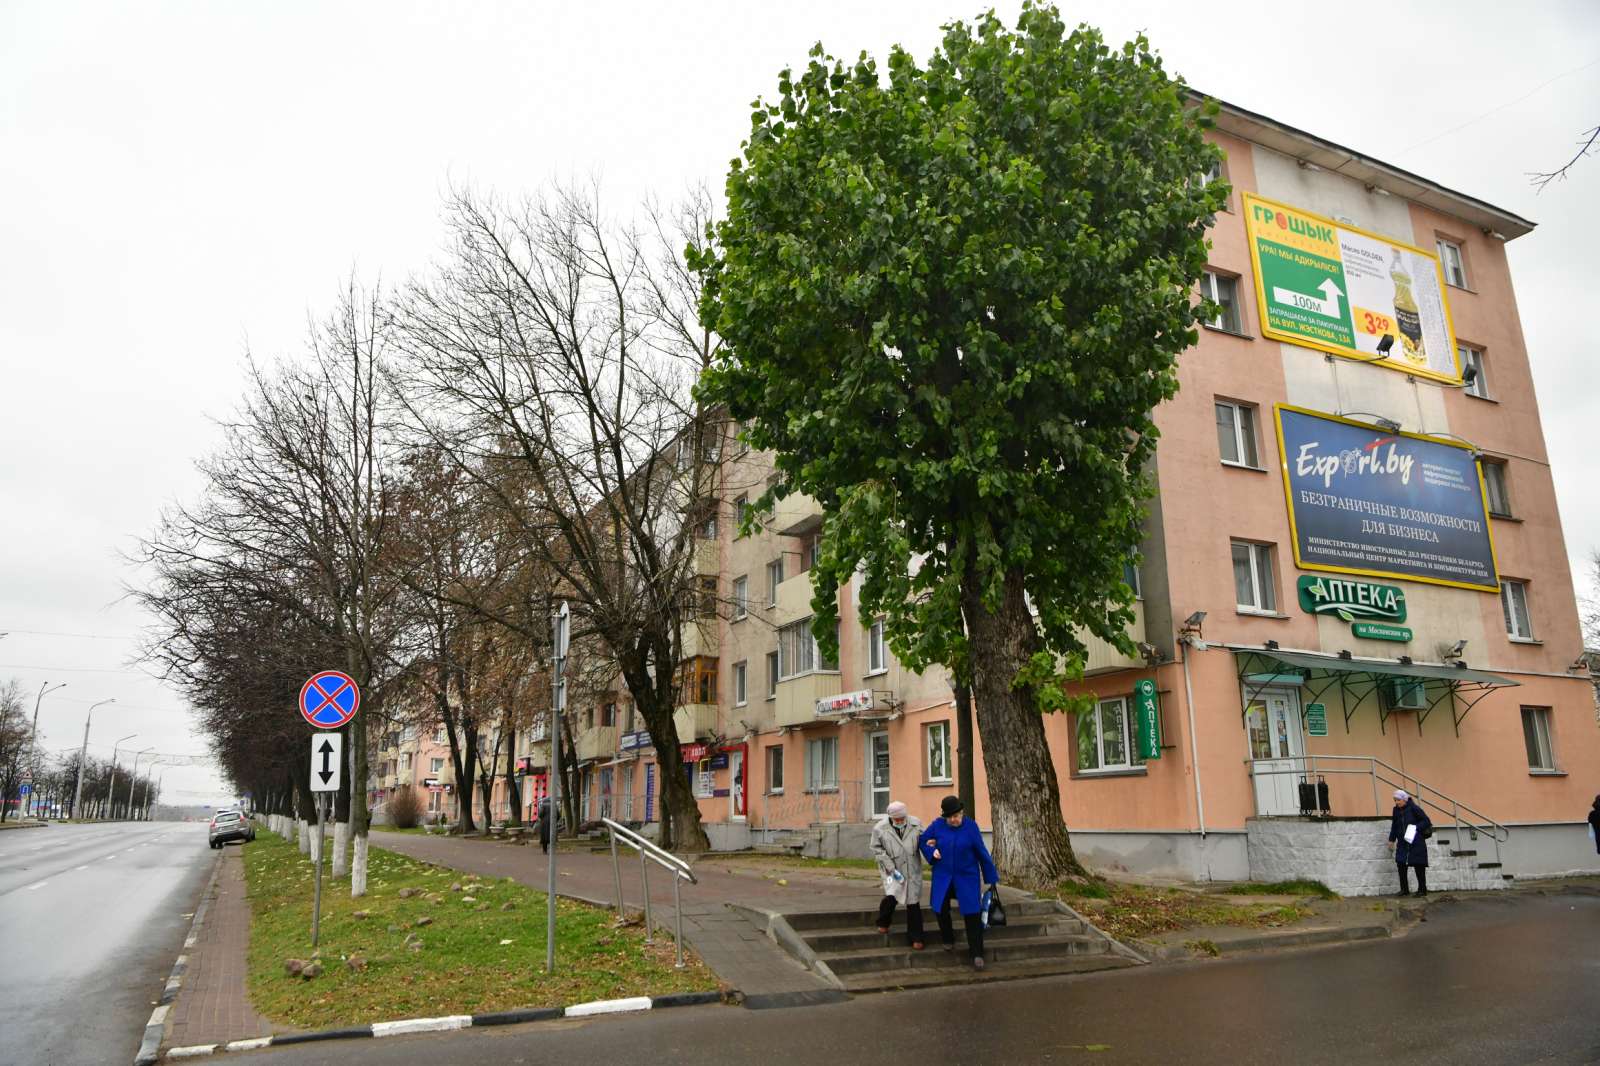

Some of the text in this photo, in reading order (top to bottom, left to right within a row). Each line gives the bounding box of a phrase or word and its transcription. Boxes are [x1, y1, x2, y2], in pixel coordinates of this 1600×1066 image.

[1301, 490, 1480, 533] БЕЗГРАНИЧНЫЕ ВОЗМОЖНОСТИ
[1362, 519, 1440, 543] ДЛЯ БИЗНЕСА
[1307, 546, 1365, 560] НАЦИОНАЛЬНЫЙ
[1308, 536, 1360, 549] МИНИСТЕРСТВО
[1361, 543, 1407, 557] ИНОСТРАННЫХ
[1316, 577, 1398, 611] АПТЕКА
[1144, 698, 1158, 757] АПТЕКА
